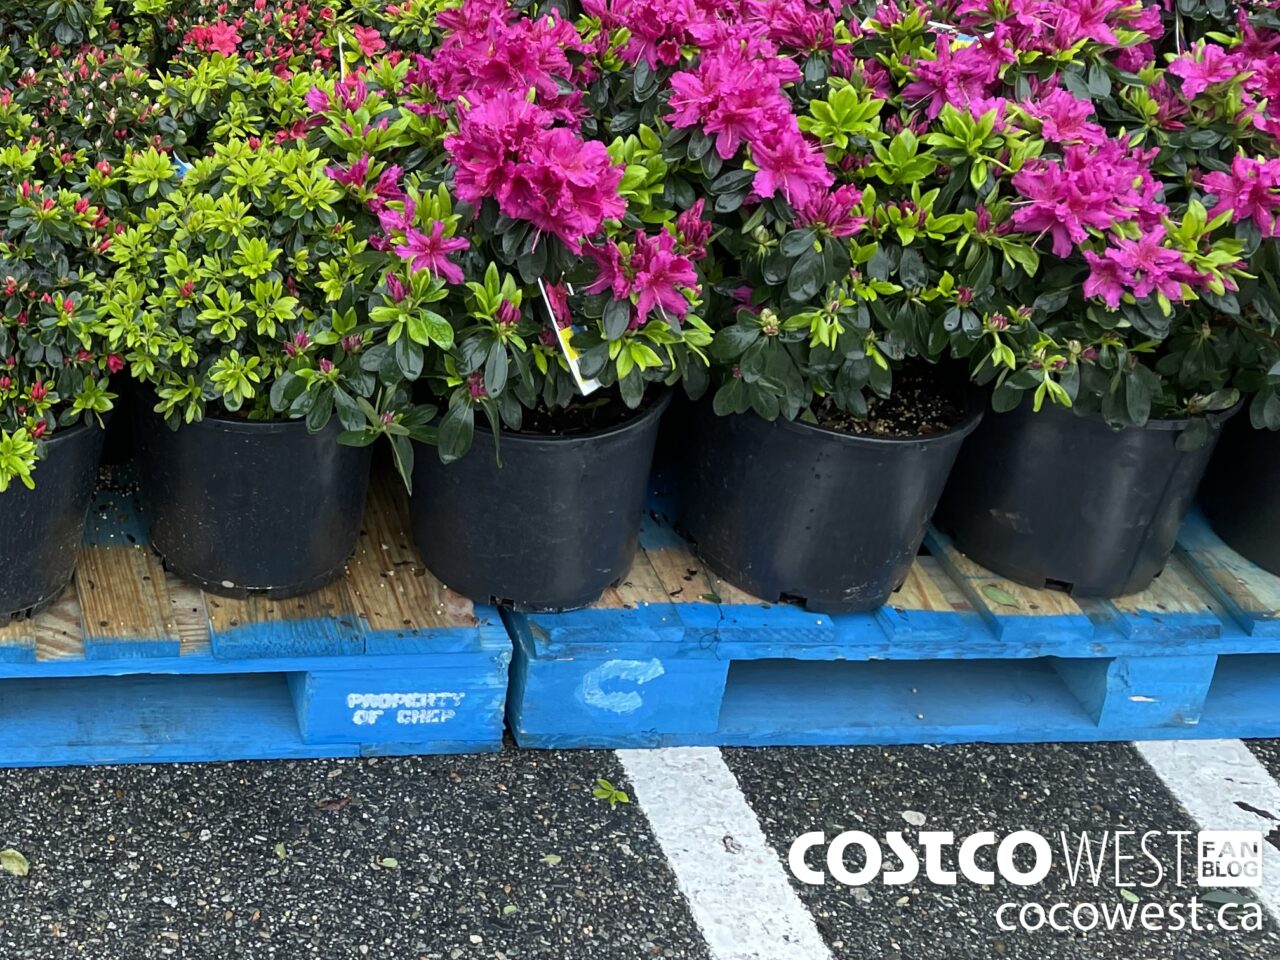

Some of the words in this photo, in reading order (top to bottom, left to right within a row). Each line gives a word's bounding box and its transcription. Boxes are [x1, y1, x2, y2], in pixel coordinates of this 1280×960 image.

[346, 692, 466, 709] PROPERTY
[352, 709, 384, 725] OF
[397, 709, 456, 724] CHEP
